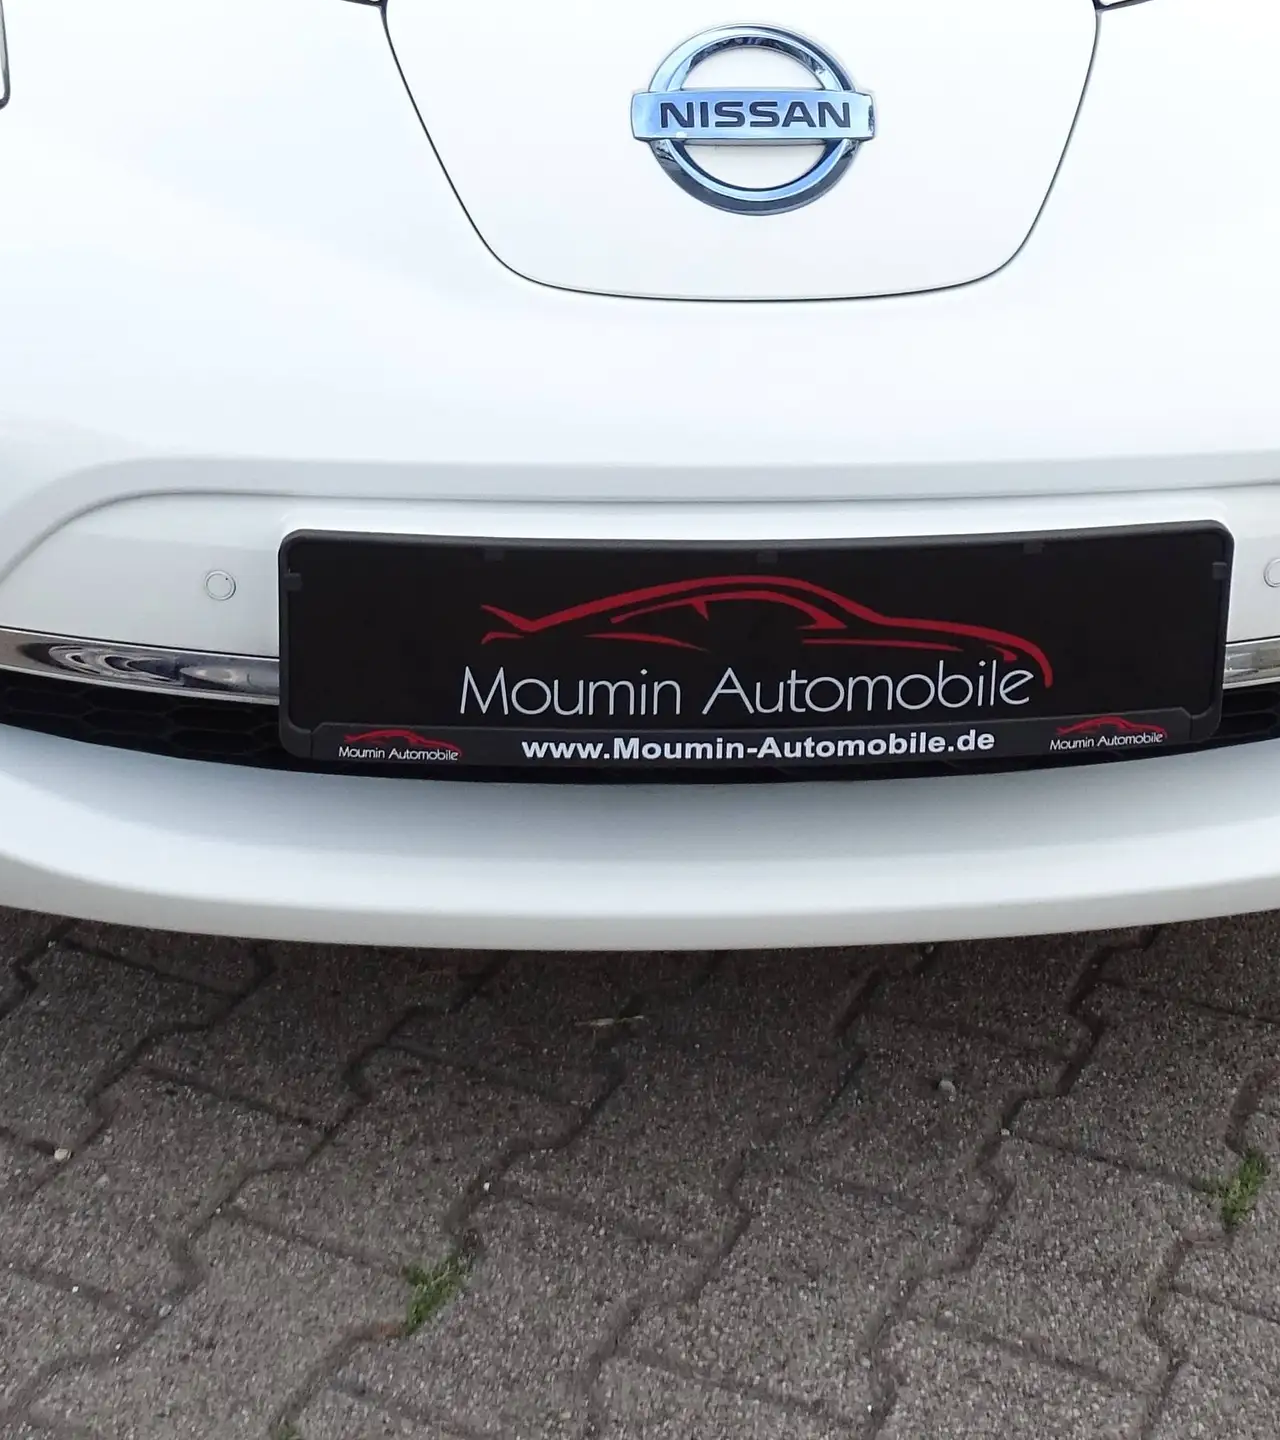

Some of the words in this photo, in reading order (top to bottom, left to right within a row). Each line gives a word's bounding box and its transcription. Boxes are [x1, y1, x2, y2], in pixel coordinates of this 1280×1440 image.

[659, 100, 852, 129] NISSAN
[459, 665, 682, 717] Moumin
[701, 659, 1035, 715] Automobile
[338, 745, 386, 759] Moumin
[388, 746, 460, 761] Automobile
[520, 728, 997, 761] www.Moumin-Automobile.de
[1049, 736, 1095, 751] Moumin
[1097, 731, 1164, 748] Automobile
